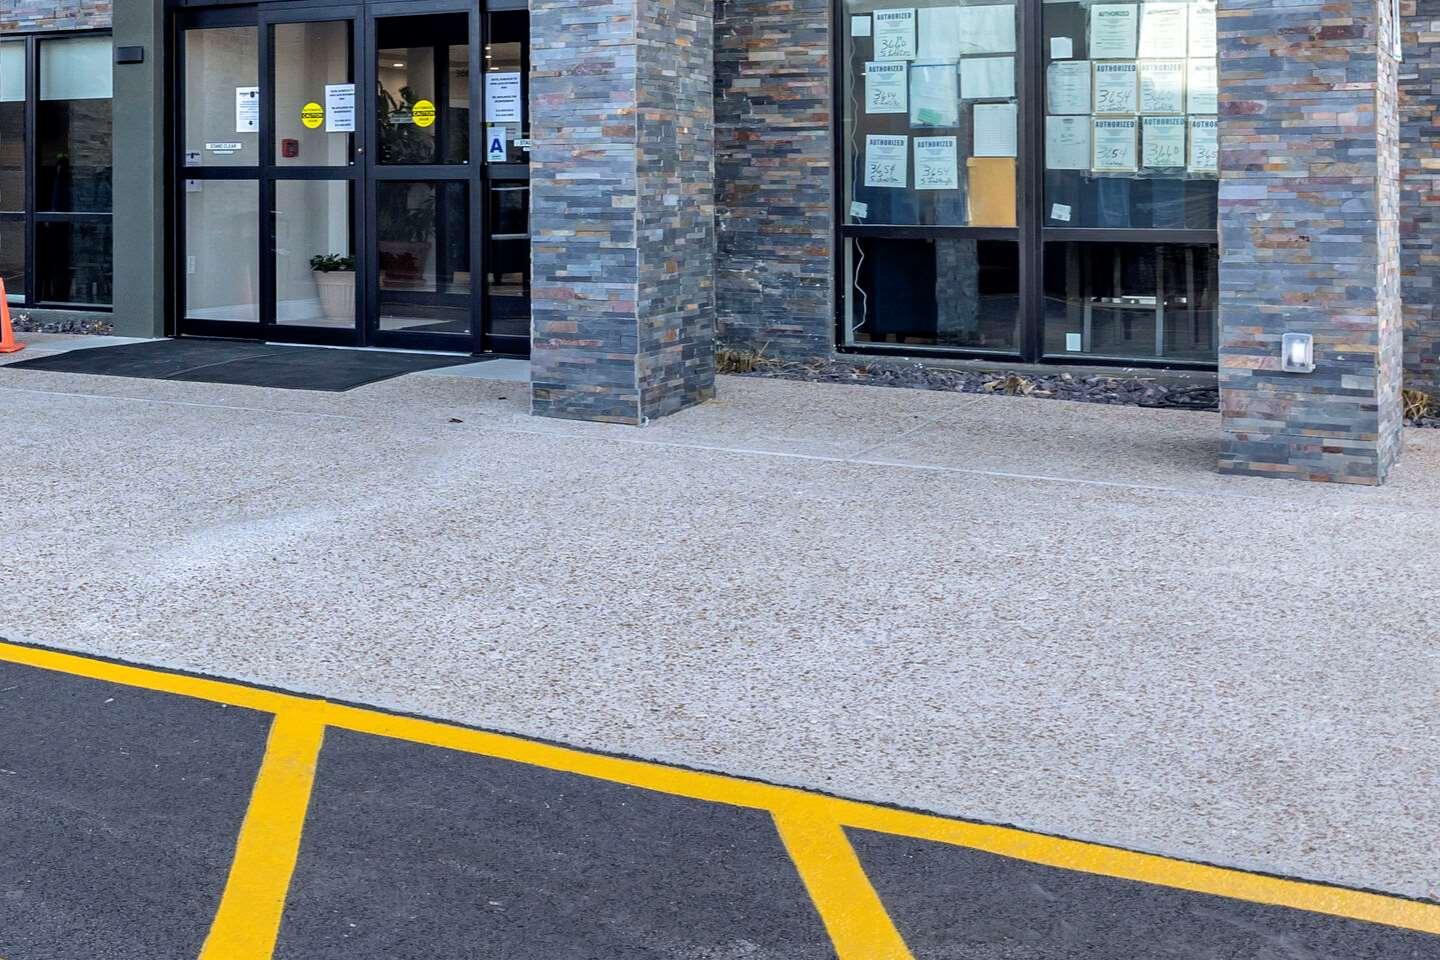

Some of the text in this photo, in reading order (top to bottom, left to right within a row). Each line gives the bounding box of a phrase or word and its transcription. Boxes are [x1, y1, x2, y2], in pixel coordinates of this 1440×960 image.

[876, 12, 912, 20] AUTHORIZED
[1097, 64, 1136, 72] AUTHORIZED
[1095, 120, 1135, 128] AUTHORIZED
[489, 138, 504, 153] A
[917, 140, 953, 148] AUTHORIZED
